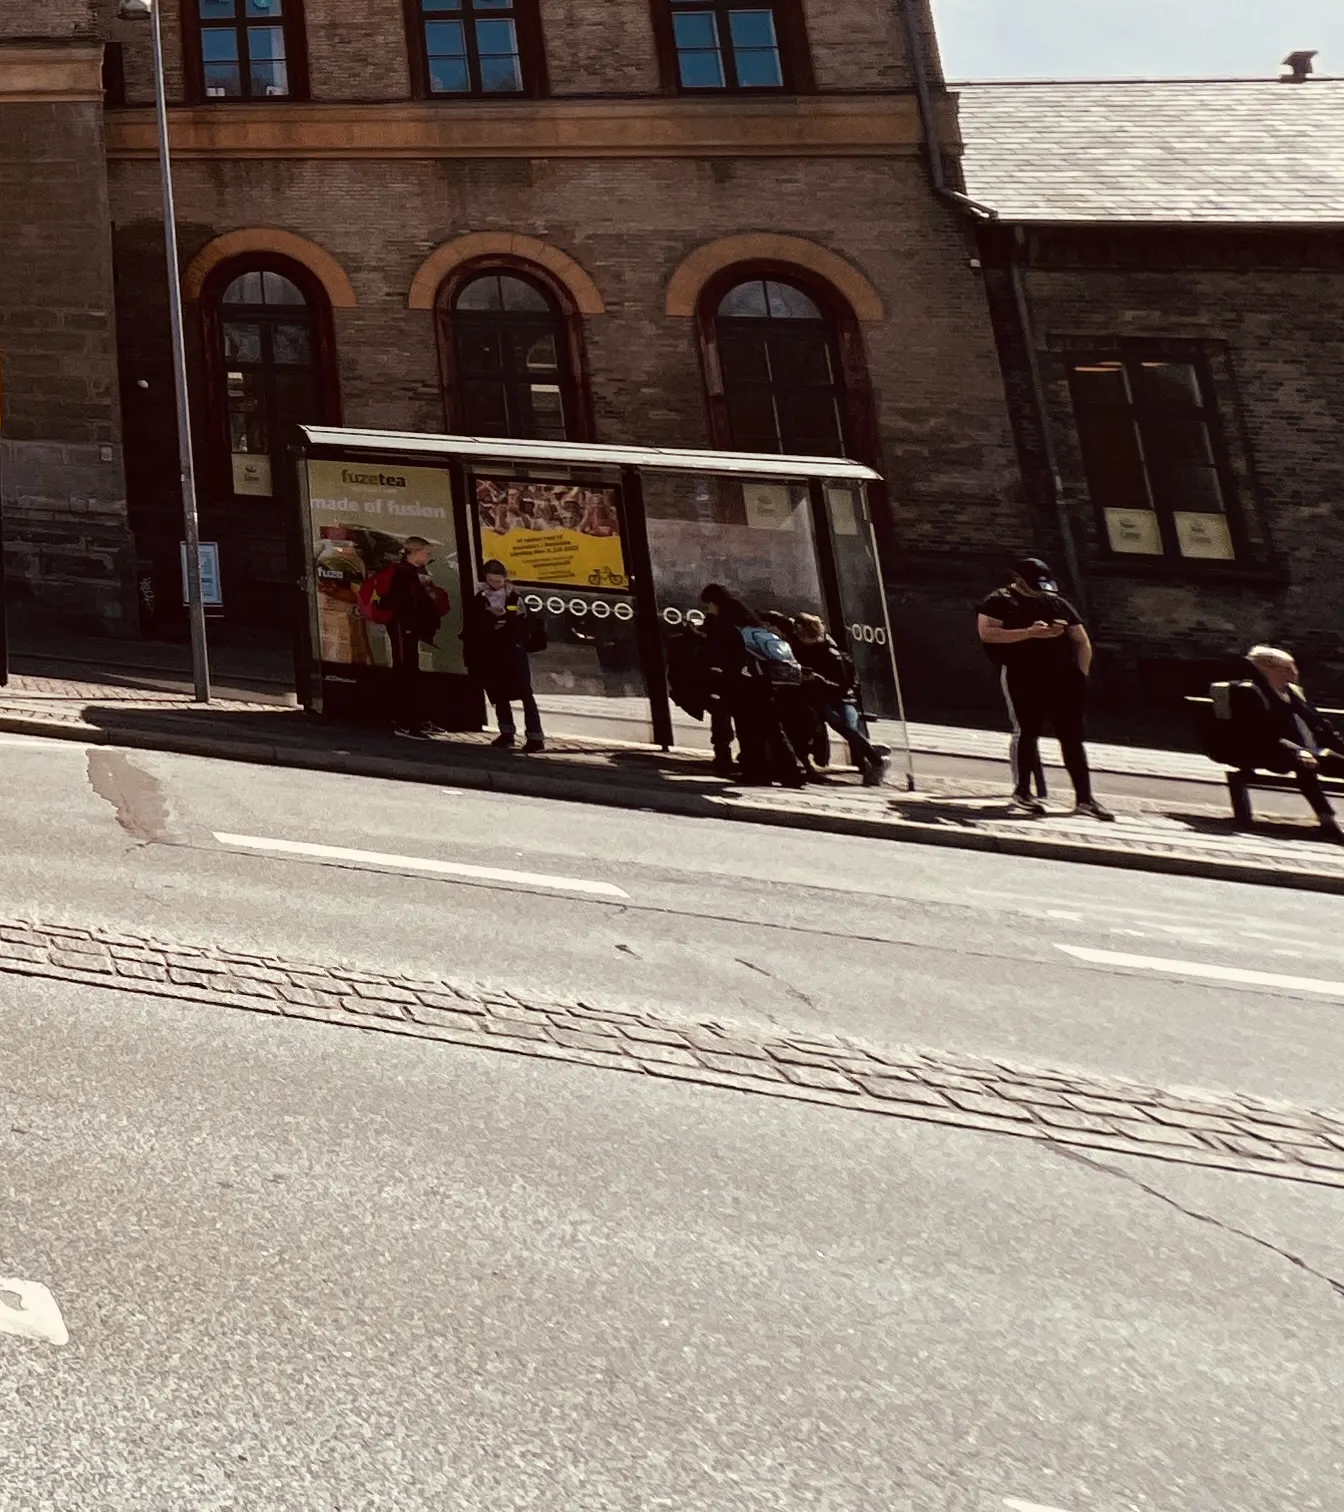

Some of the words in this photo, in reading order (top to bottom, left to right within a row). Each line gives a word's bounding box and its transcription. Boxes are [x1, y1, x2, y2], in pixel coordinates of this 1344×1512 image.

[341, 469, 407, 488] fuzetea
[311, 497, 360, 512] made
[364, 499, 382, 514] of
[387, 500, 446, 518] fusion
